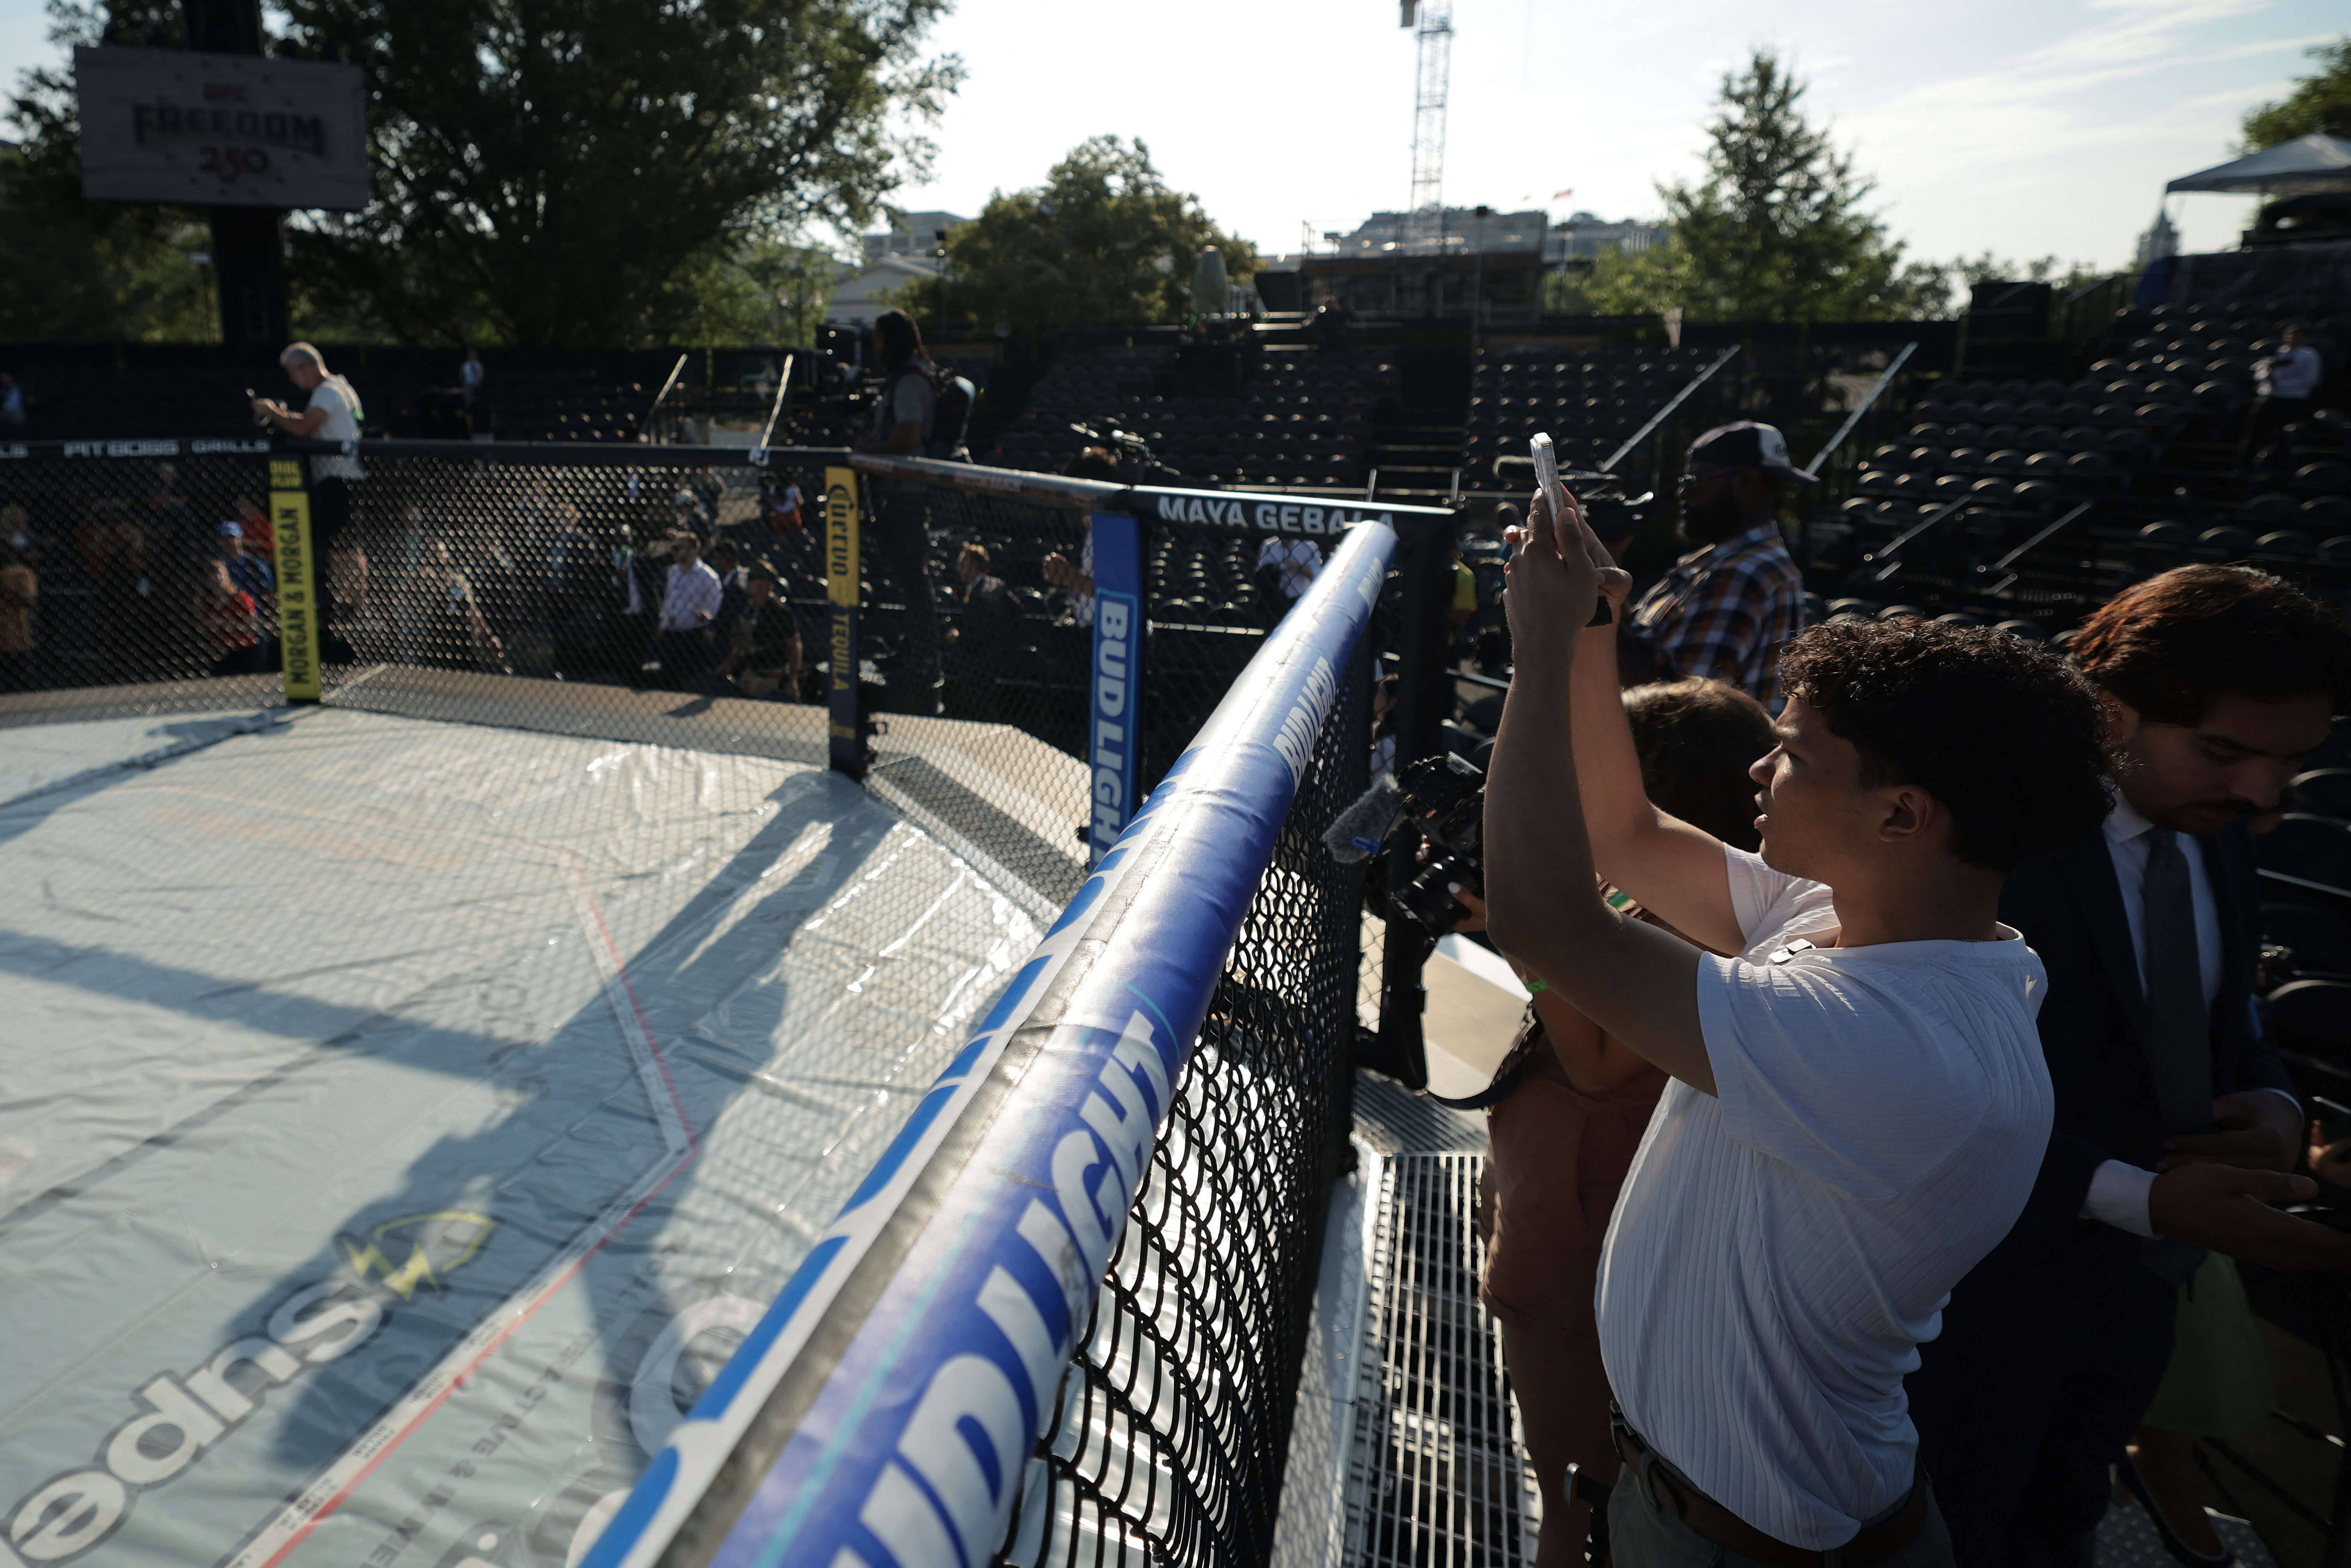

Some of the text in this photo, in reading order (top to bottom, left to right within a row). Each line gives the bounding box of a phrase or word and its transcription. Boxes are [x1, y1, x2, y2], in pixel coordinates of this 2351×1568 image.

[132, 102, 328, 156] FREEDOM
[199, 146, 270, 183] 250
[190, 439, 272, 454] GRILLS
[827, 484, 856, 576] Cuervo
[1157, 496, 1249, 529] MAYA
[280, 506, 311, 685] MORGAN & MORGAN
[830, 614, 850, 690] TEQUILA
[1097, 600, 1129, 718] BUD
[1272, 656, 1337, 796] BUD LIGHT
[0, 1279, 384, 1568] Supe
[352, 1425, 389, 1458] SILLER
[361, 1429, 395, 1460] FRANK
[449, 1460, 477, 1479] &
[361, 1484, 458, 1568] IMME
